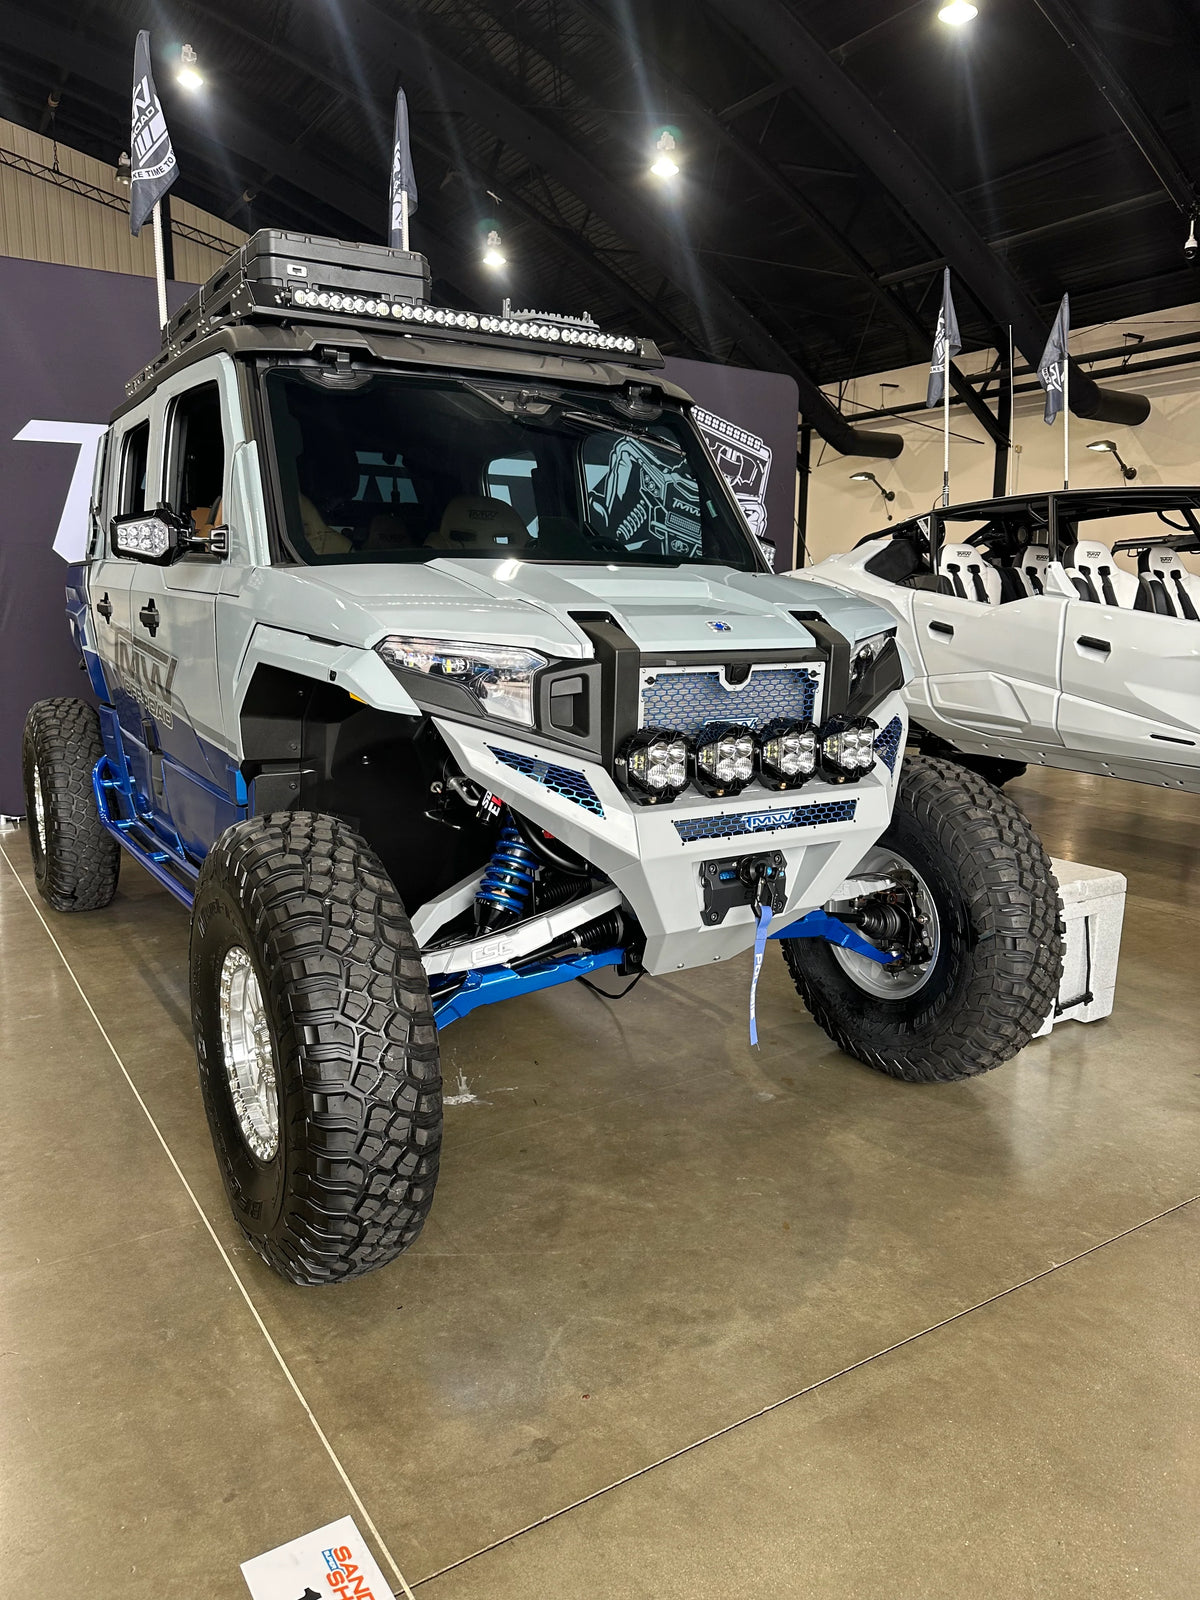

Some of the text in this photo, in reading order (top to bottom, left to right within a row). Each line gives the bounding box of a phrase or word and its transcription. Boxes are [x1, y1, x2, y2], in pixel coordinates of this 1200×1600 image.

[145, 166, 165, 177] TIME
[164, 157, 174, 167] TO
[741, 808, 796, 832] TMW
